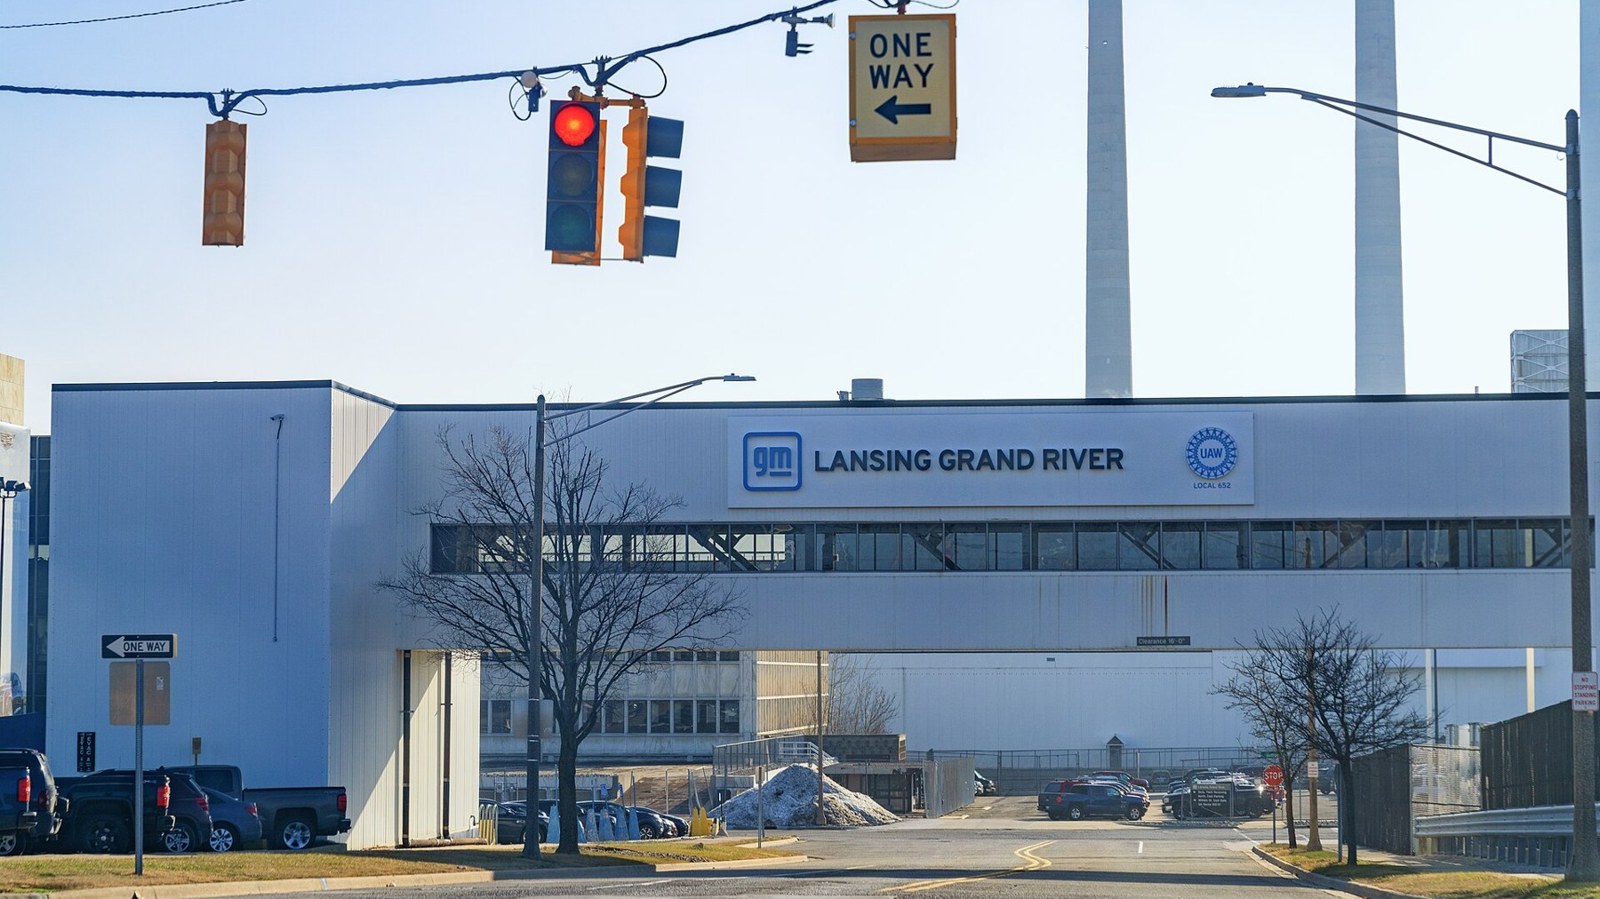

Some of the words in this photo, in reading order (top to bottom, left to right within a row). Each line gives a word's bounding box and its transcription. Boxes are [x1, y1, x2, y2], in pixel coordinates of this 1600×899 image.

[869, 32, 933, 58] ONE
[868, 63, 935, 89] WAY
[753, 447, 792, 477] gm
[814, 449, 932, 472] LANSING
[938, 448, 1035, 471] GRAND
[1042, 448, 1124, 470] RIVER
[1200, 448, 1223, 459] UAW
[123, 641, 144, 652] ONE
[146, 641, 166, 652] WAY
[1264, 771, 1283, 780] STOP
